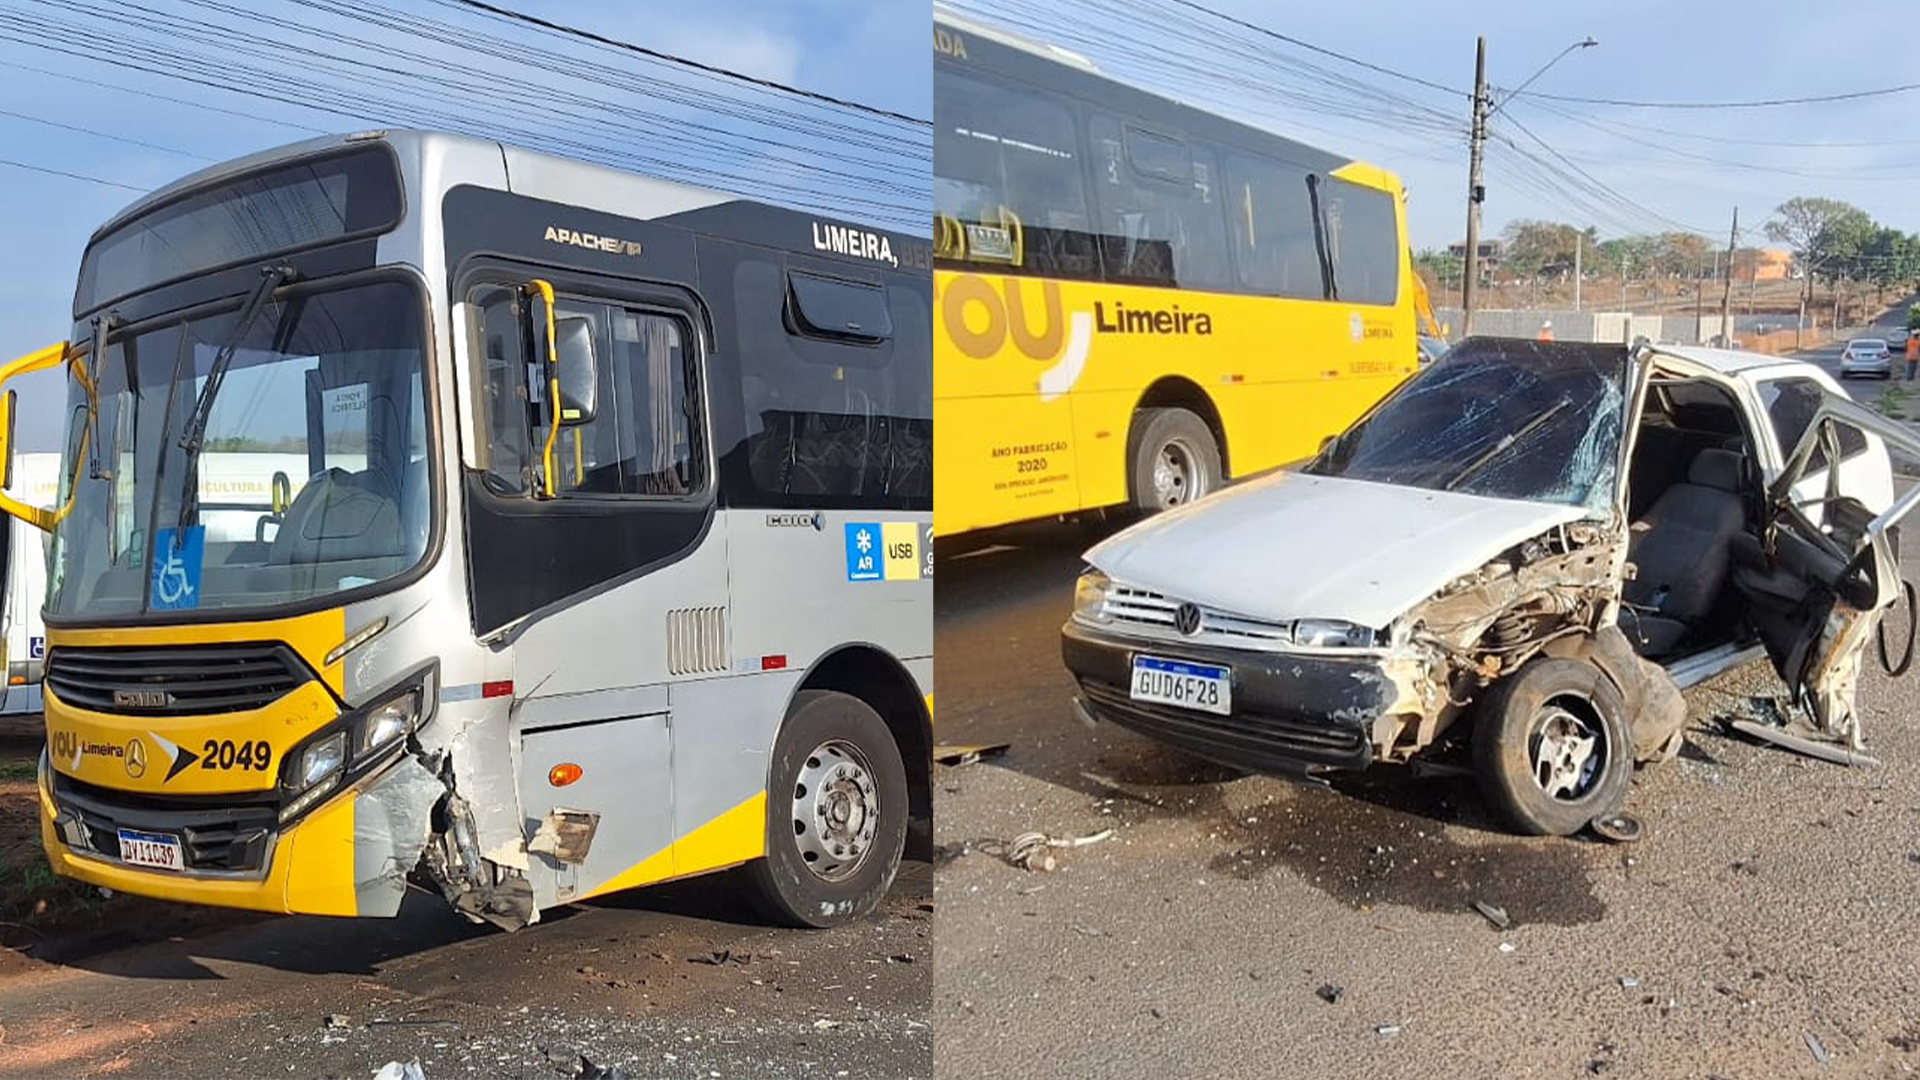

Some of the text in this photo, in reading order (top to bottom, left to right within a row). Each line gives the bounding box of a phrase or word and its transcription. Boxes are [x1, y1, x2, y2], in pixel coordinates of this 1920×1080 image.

[812, 221, 898, 268] LIMEIRA,
[1094, 300, 1212, 335] Limeira
[992, 447, 1011, 458] ANO
[1018, 457, 1048, 473] 2020
[889, 543, 913, 559] USB
[858, 556, 873, 571] AR
[1140, 671, 1219, 706] GUD6F28
[82, 741, 124, 757] Limeira
[201, 740, 271, 771] 2049
